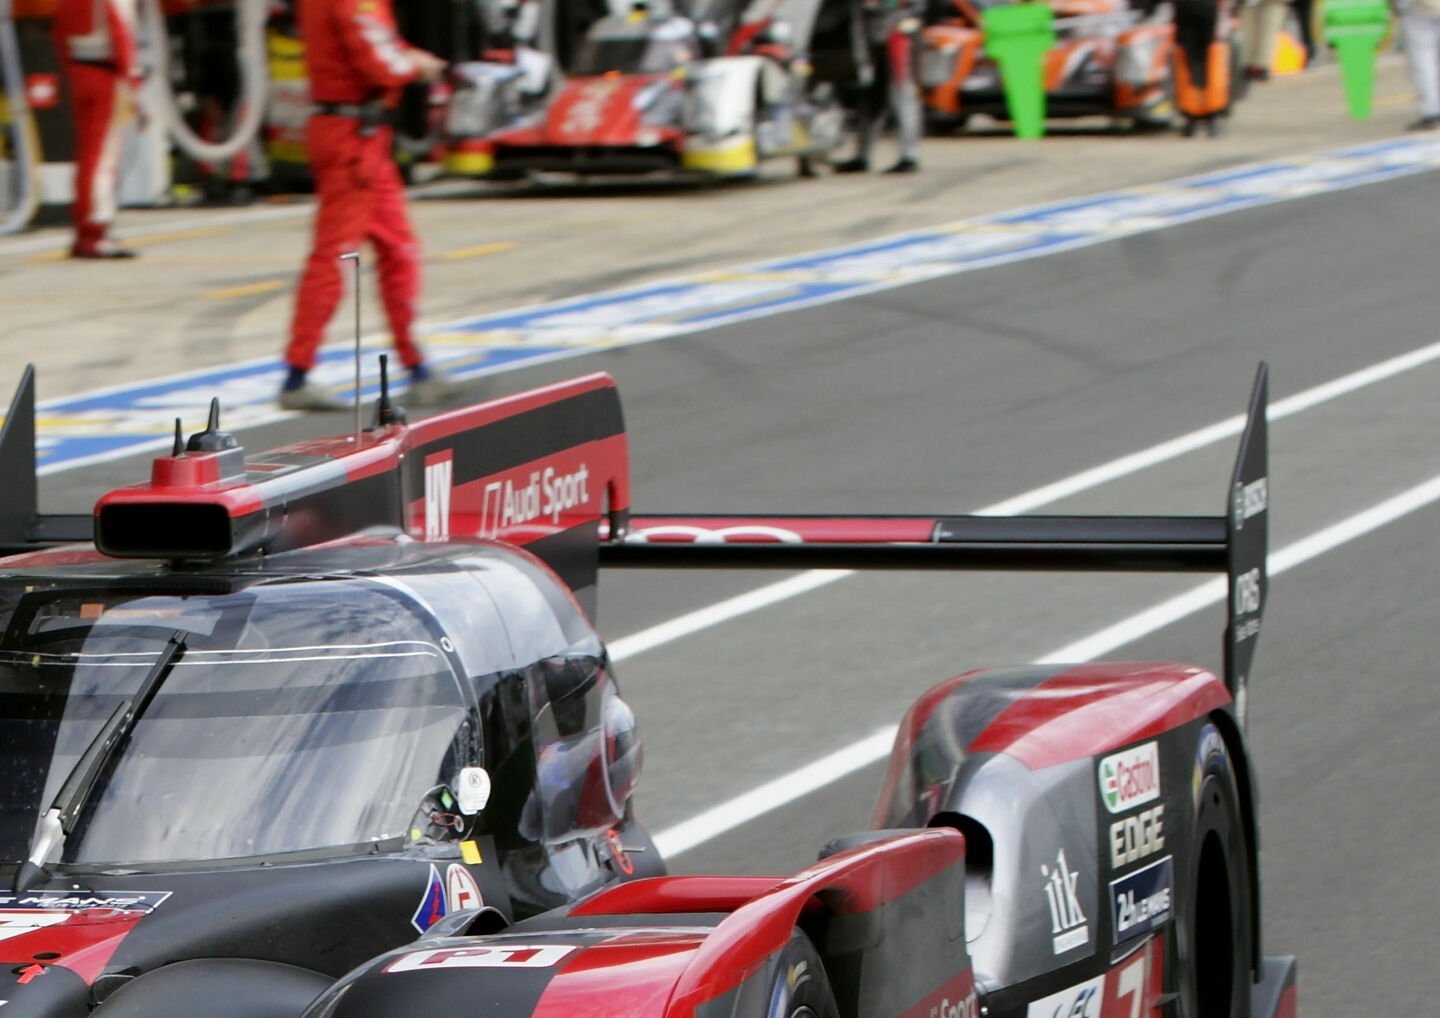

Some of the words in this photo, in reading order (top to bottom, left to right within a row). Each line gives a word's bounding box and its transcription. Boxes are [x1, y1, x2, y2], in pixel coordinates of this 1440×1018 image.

[424, 459, 453, 542] HY
[501, 471, 541, 528] Audi
[542, 462, 590, 525] Sport
[1117, 751, 1157, 803] Castrol
[1110, 804, 1165, 869] EDGE
[1040, 847, 1087, 934] itk
[418, 948, 545, 965] P1
